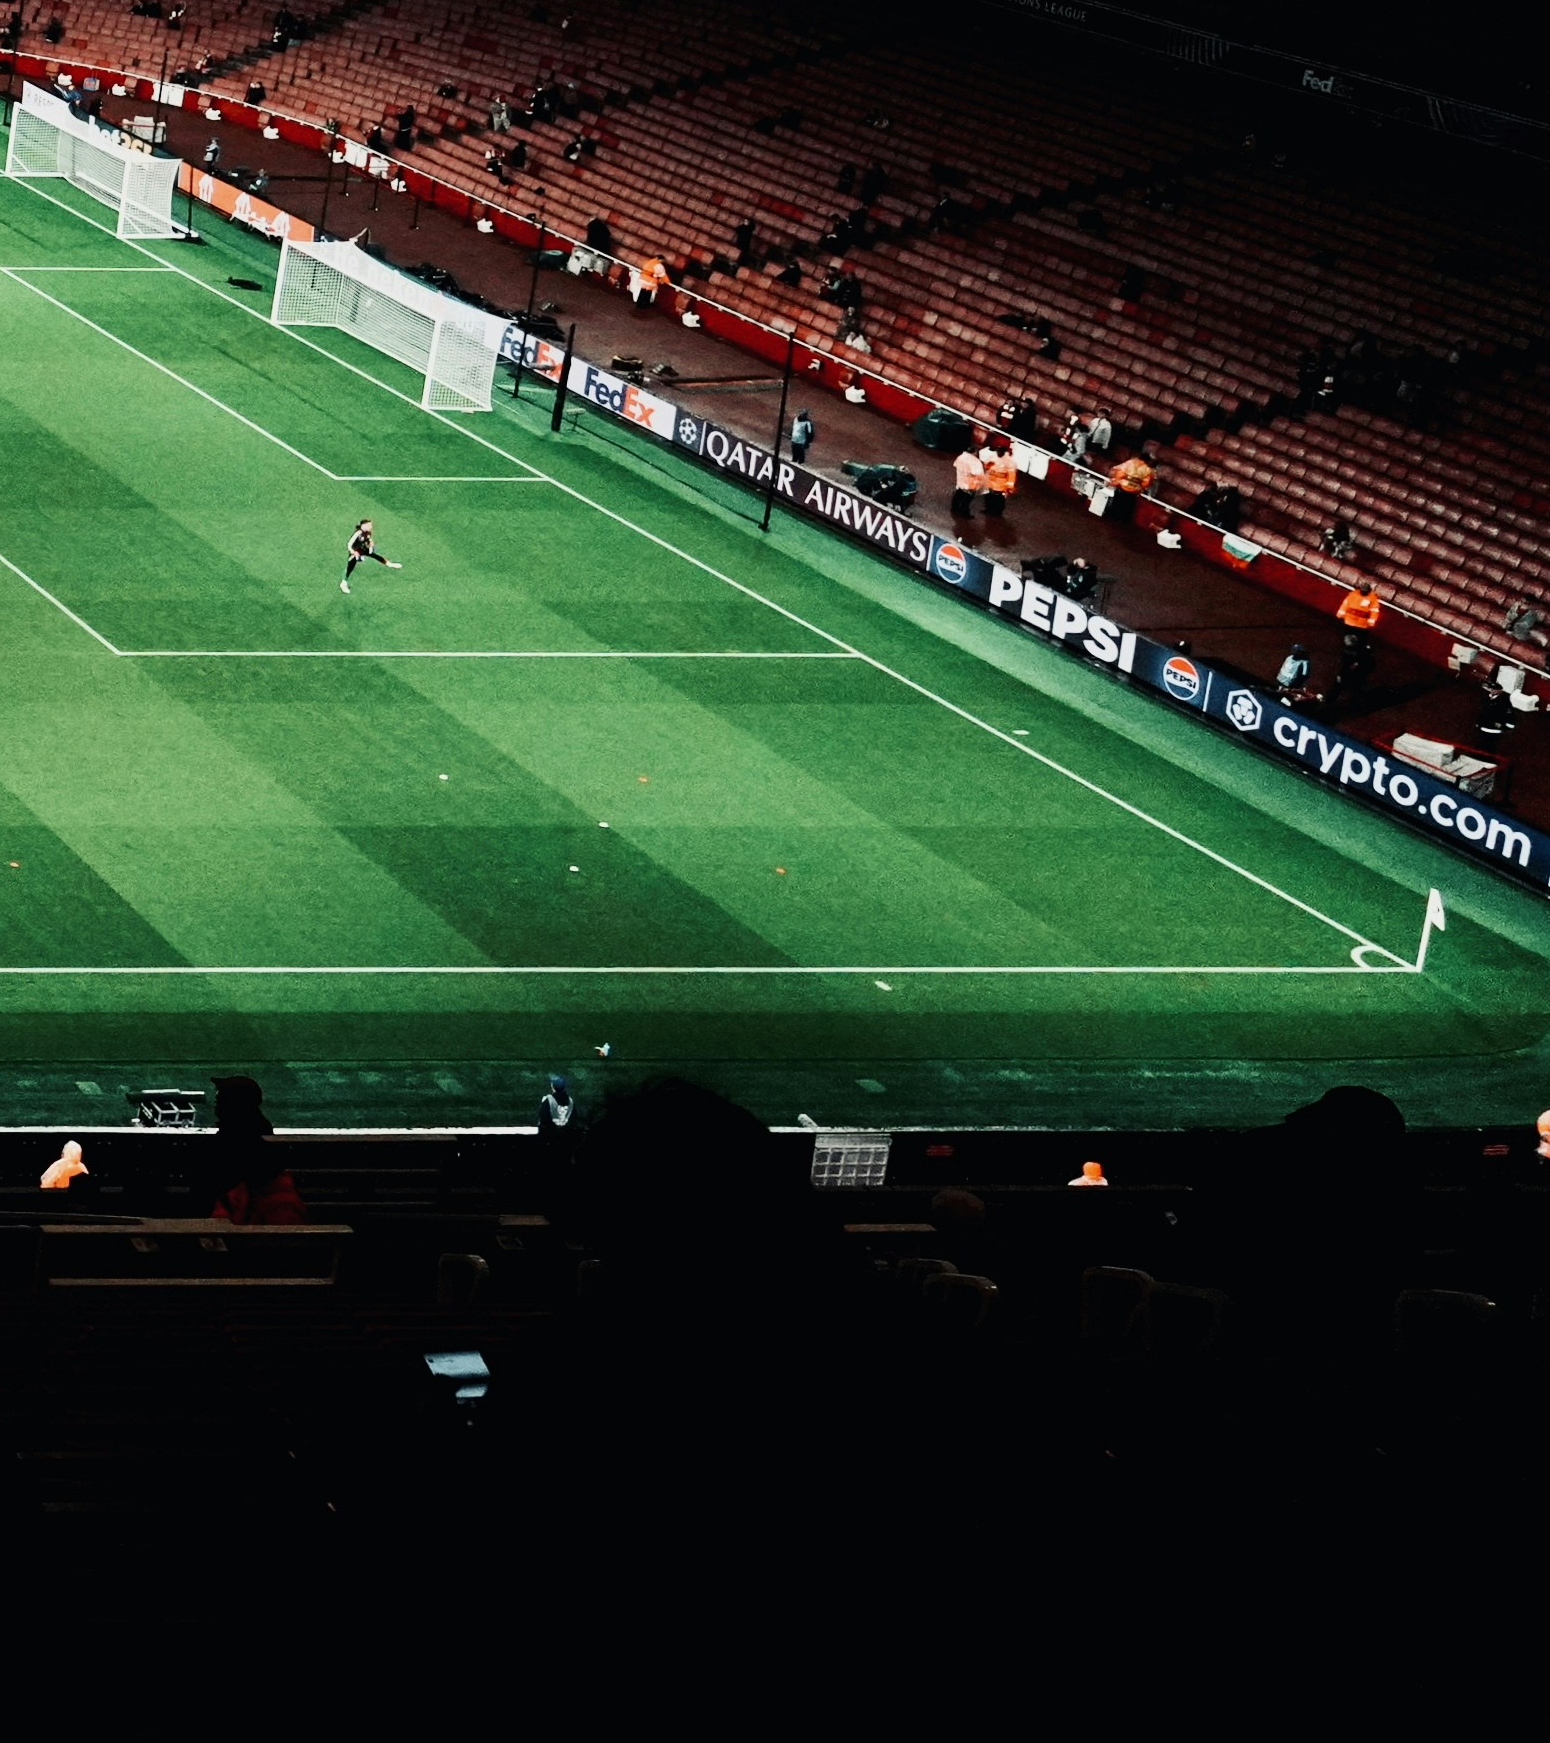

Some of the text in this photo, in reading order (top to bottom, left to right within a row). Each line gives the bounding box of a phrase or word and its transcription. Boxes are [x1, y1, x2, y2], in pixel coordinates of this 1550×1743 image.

[583, 366, 654, 428] FedEx
[706, 430, 929, 562] QATAR AIRWAYS
[938, 555, 964, 572] PEPSI
[988, 564, 1137, 674] PEPSI
[1166, 667, 1197, 690] PEPSI
[1272, 715, 1533, 868] crypto.com
